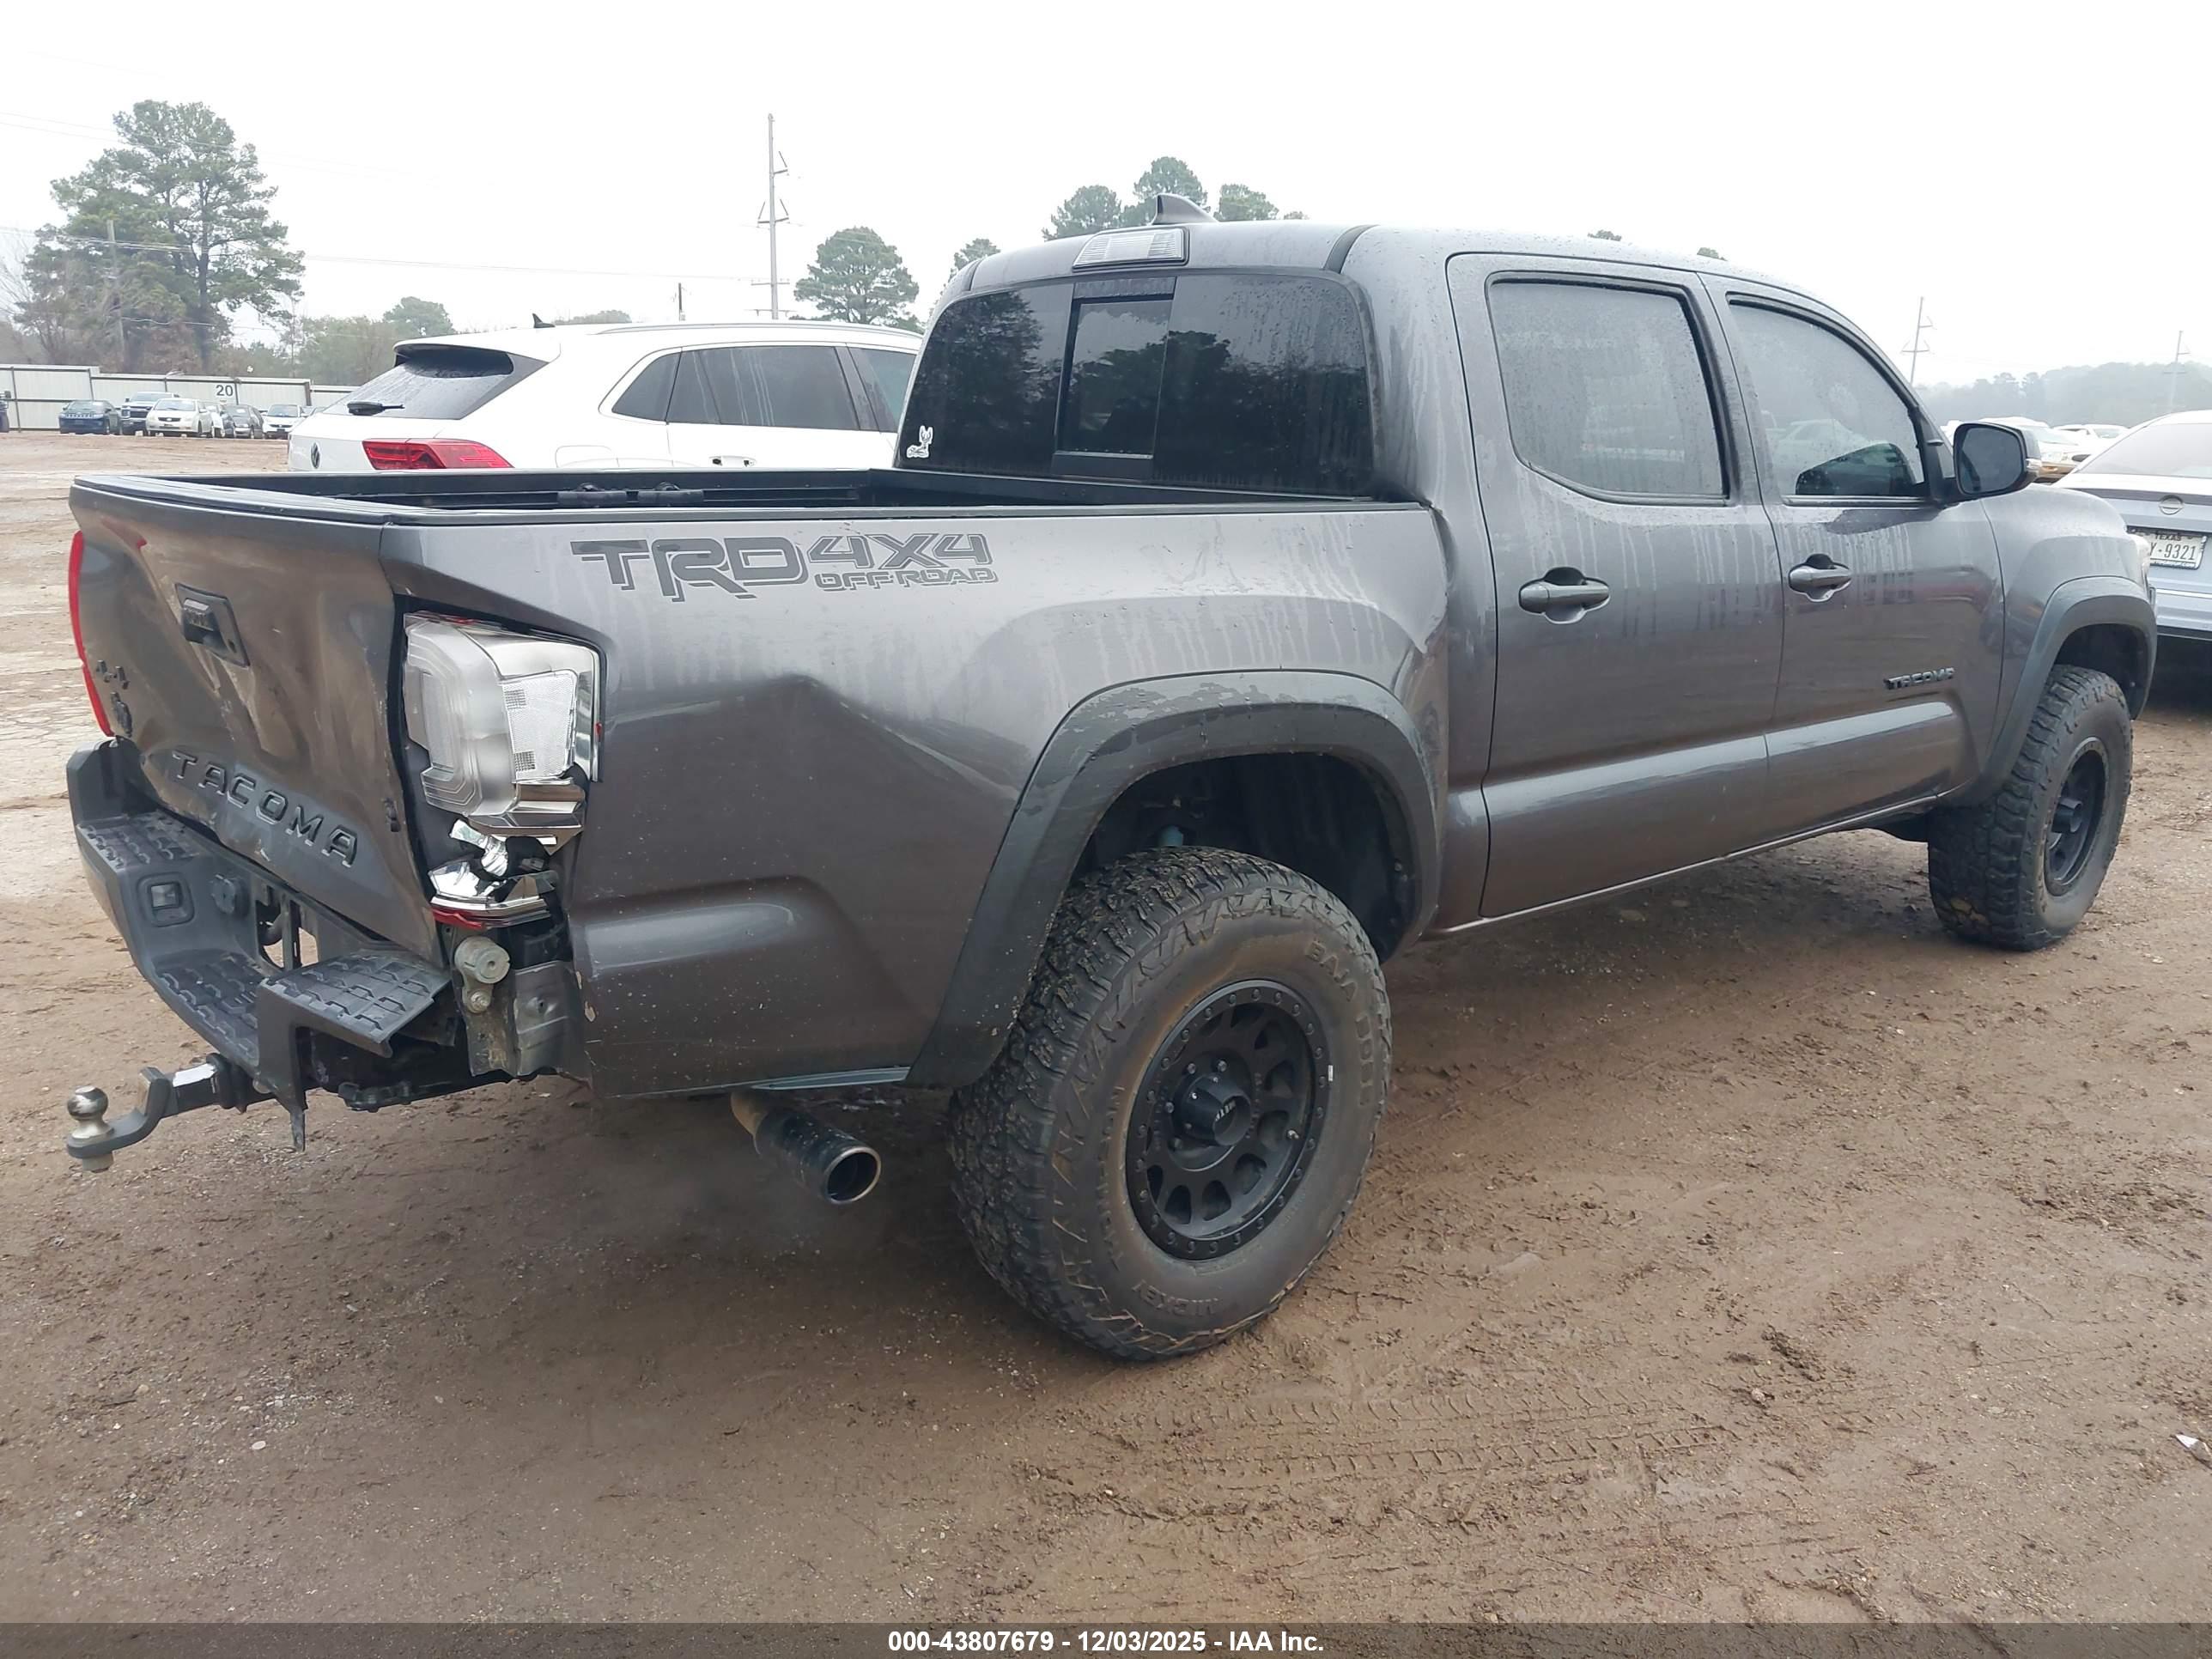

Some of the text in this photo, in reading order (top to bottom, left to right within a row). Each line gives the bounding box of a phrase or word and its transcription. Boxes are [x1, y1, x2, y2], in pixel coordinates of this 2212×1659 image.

[216, 384, 234, 397] 20
[570, 533, 994, 602] TRD 4X4
[814, 568, 999, 592] OFF ROAD
[173, 750, 358, 868] TACOMA
